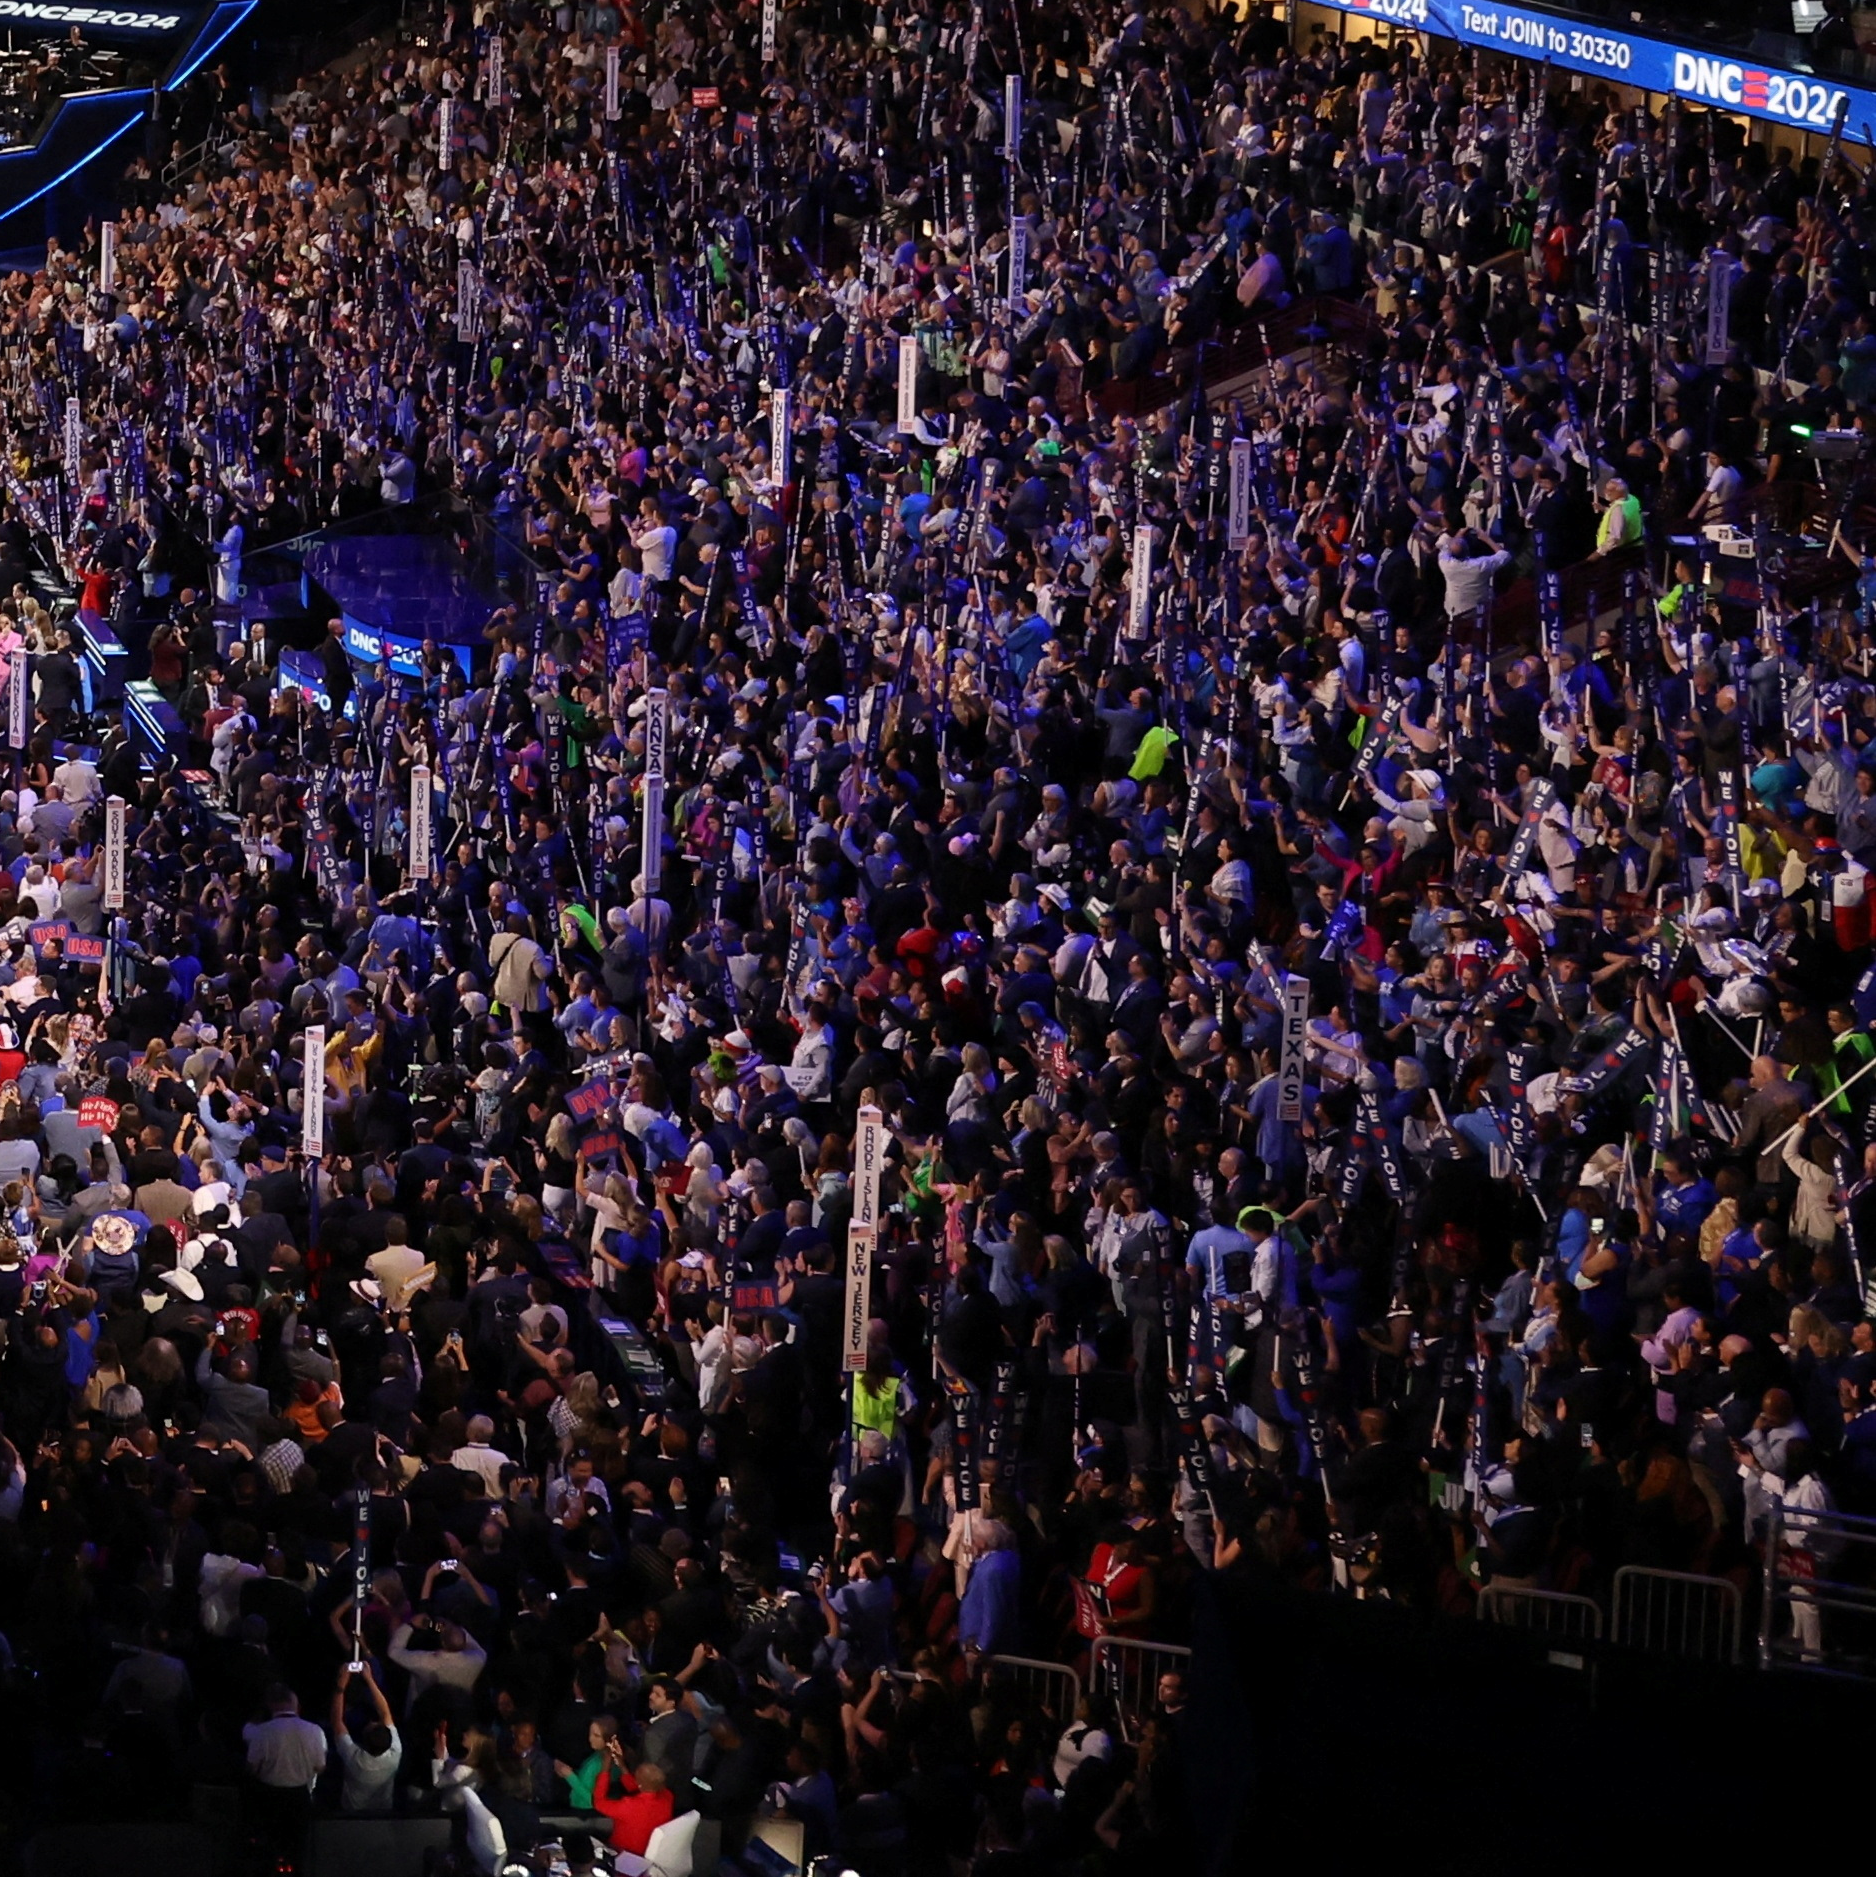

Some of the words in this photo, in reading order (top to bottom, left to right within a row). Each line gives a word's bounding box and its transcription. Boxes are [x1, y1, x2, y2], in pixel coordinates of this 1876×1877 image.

[1462, 5, 1498, 35] Text
[1500, 16, 1544, 47] JOIN
[1548, 30, 1566, 52] to
[1570, 32, 1630, 68] 30330
[1014, 227, 1025, 298] WYOMING
[69, 408, 81, 470] OKLAHOMA
[773, 402, 785, 472] NEVADA
[12, 660, 24, 734] MINNESOTA
[417, 780, 425, 811] SOUTH
[1719, 771, 1734, 800] WE
[110, 811, 120, 845] SOUTH
[417, 814, 425, 864] CAROLINA
[1724, 823, 1738, 867] JOE
[110, 850, 120, 891] DAKOTA
[67, 939, 103, 957] USA
[1283, 995, 1305, 1101] TEXAS
[1506, 1051, 1524, 1081] WE
[570, 1085, 607, 1116] USA
[1511, 1102, 1525, 1147] JOE
[864, 1125, 874, 1171] RHODE
[862, 1177, 872, 1225] ISLAN
[852, 1241, 867, 1276] NEW
[734, 1287, 775, 1309] USA
[850, 1280, 863, 1351] JERSEY
